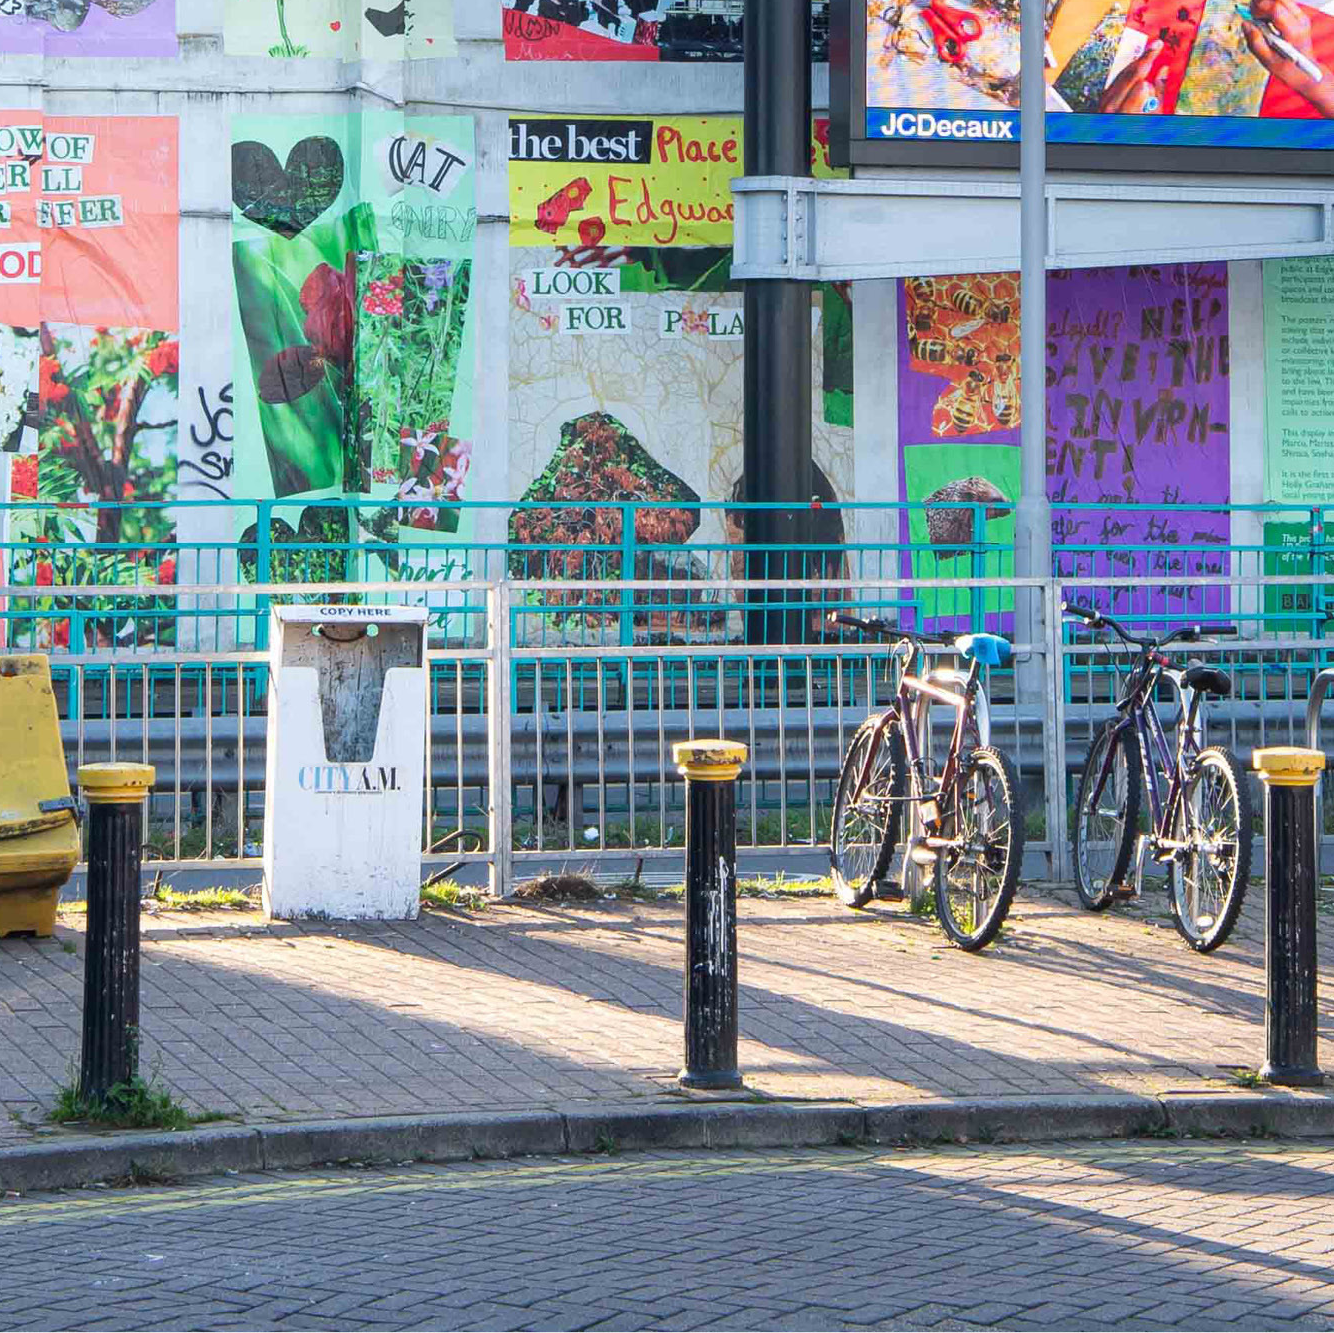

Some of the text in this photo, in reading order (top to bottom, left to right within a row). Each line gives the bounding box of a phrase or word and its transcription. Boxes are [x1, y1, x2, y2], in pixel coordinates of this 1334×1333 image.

[881, 113, 1014, 138] JCDecaux
[50, 136, 90, 160] OF
[509, 124, 737, 163] the best Place
[533, 272, 615, 295] LOOK
[566, 307, 625, 330] FOR
[320, 607, 392, 617] COPY HERE
[298, 766, 401, 791] CITY A.M.
